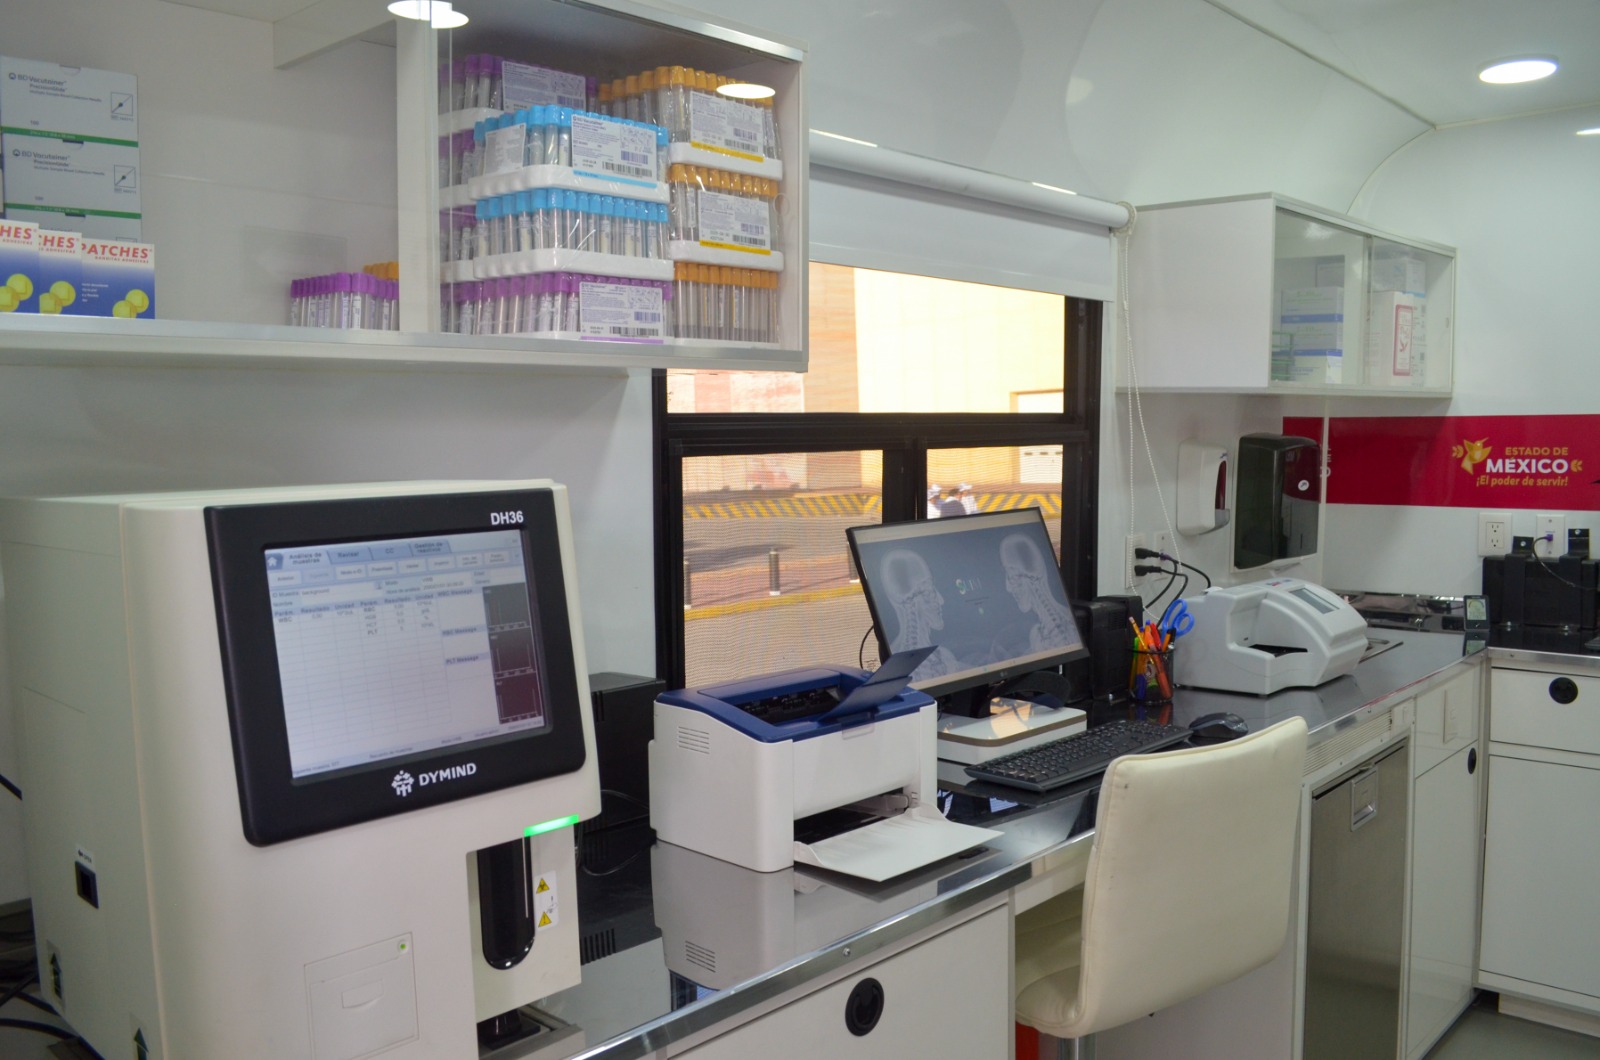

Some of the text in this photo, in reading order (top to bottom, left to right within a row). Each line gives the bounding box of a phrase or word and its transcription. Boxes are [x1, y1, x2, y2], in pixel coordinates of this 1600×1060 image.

[1505, 447, 1568, 456] ESTADO DE
[1486, 457, 1569, 474] MÉXICO
[1491, 476, 1519, 487] poder
[1522, 476, 1534, 486] de
[1537, 476, 1568, 486] servir!
[490, 510, 524, 525] DH36
[418, 763, 477, 786] DYMIND
